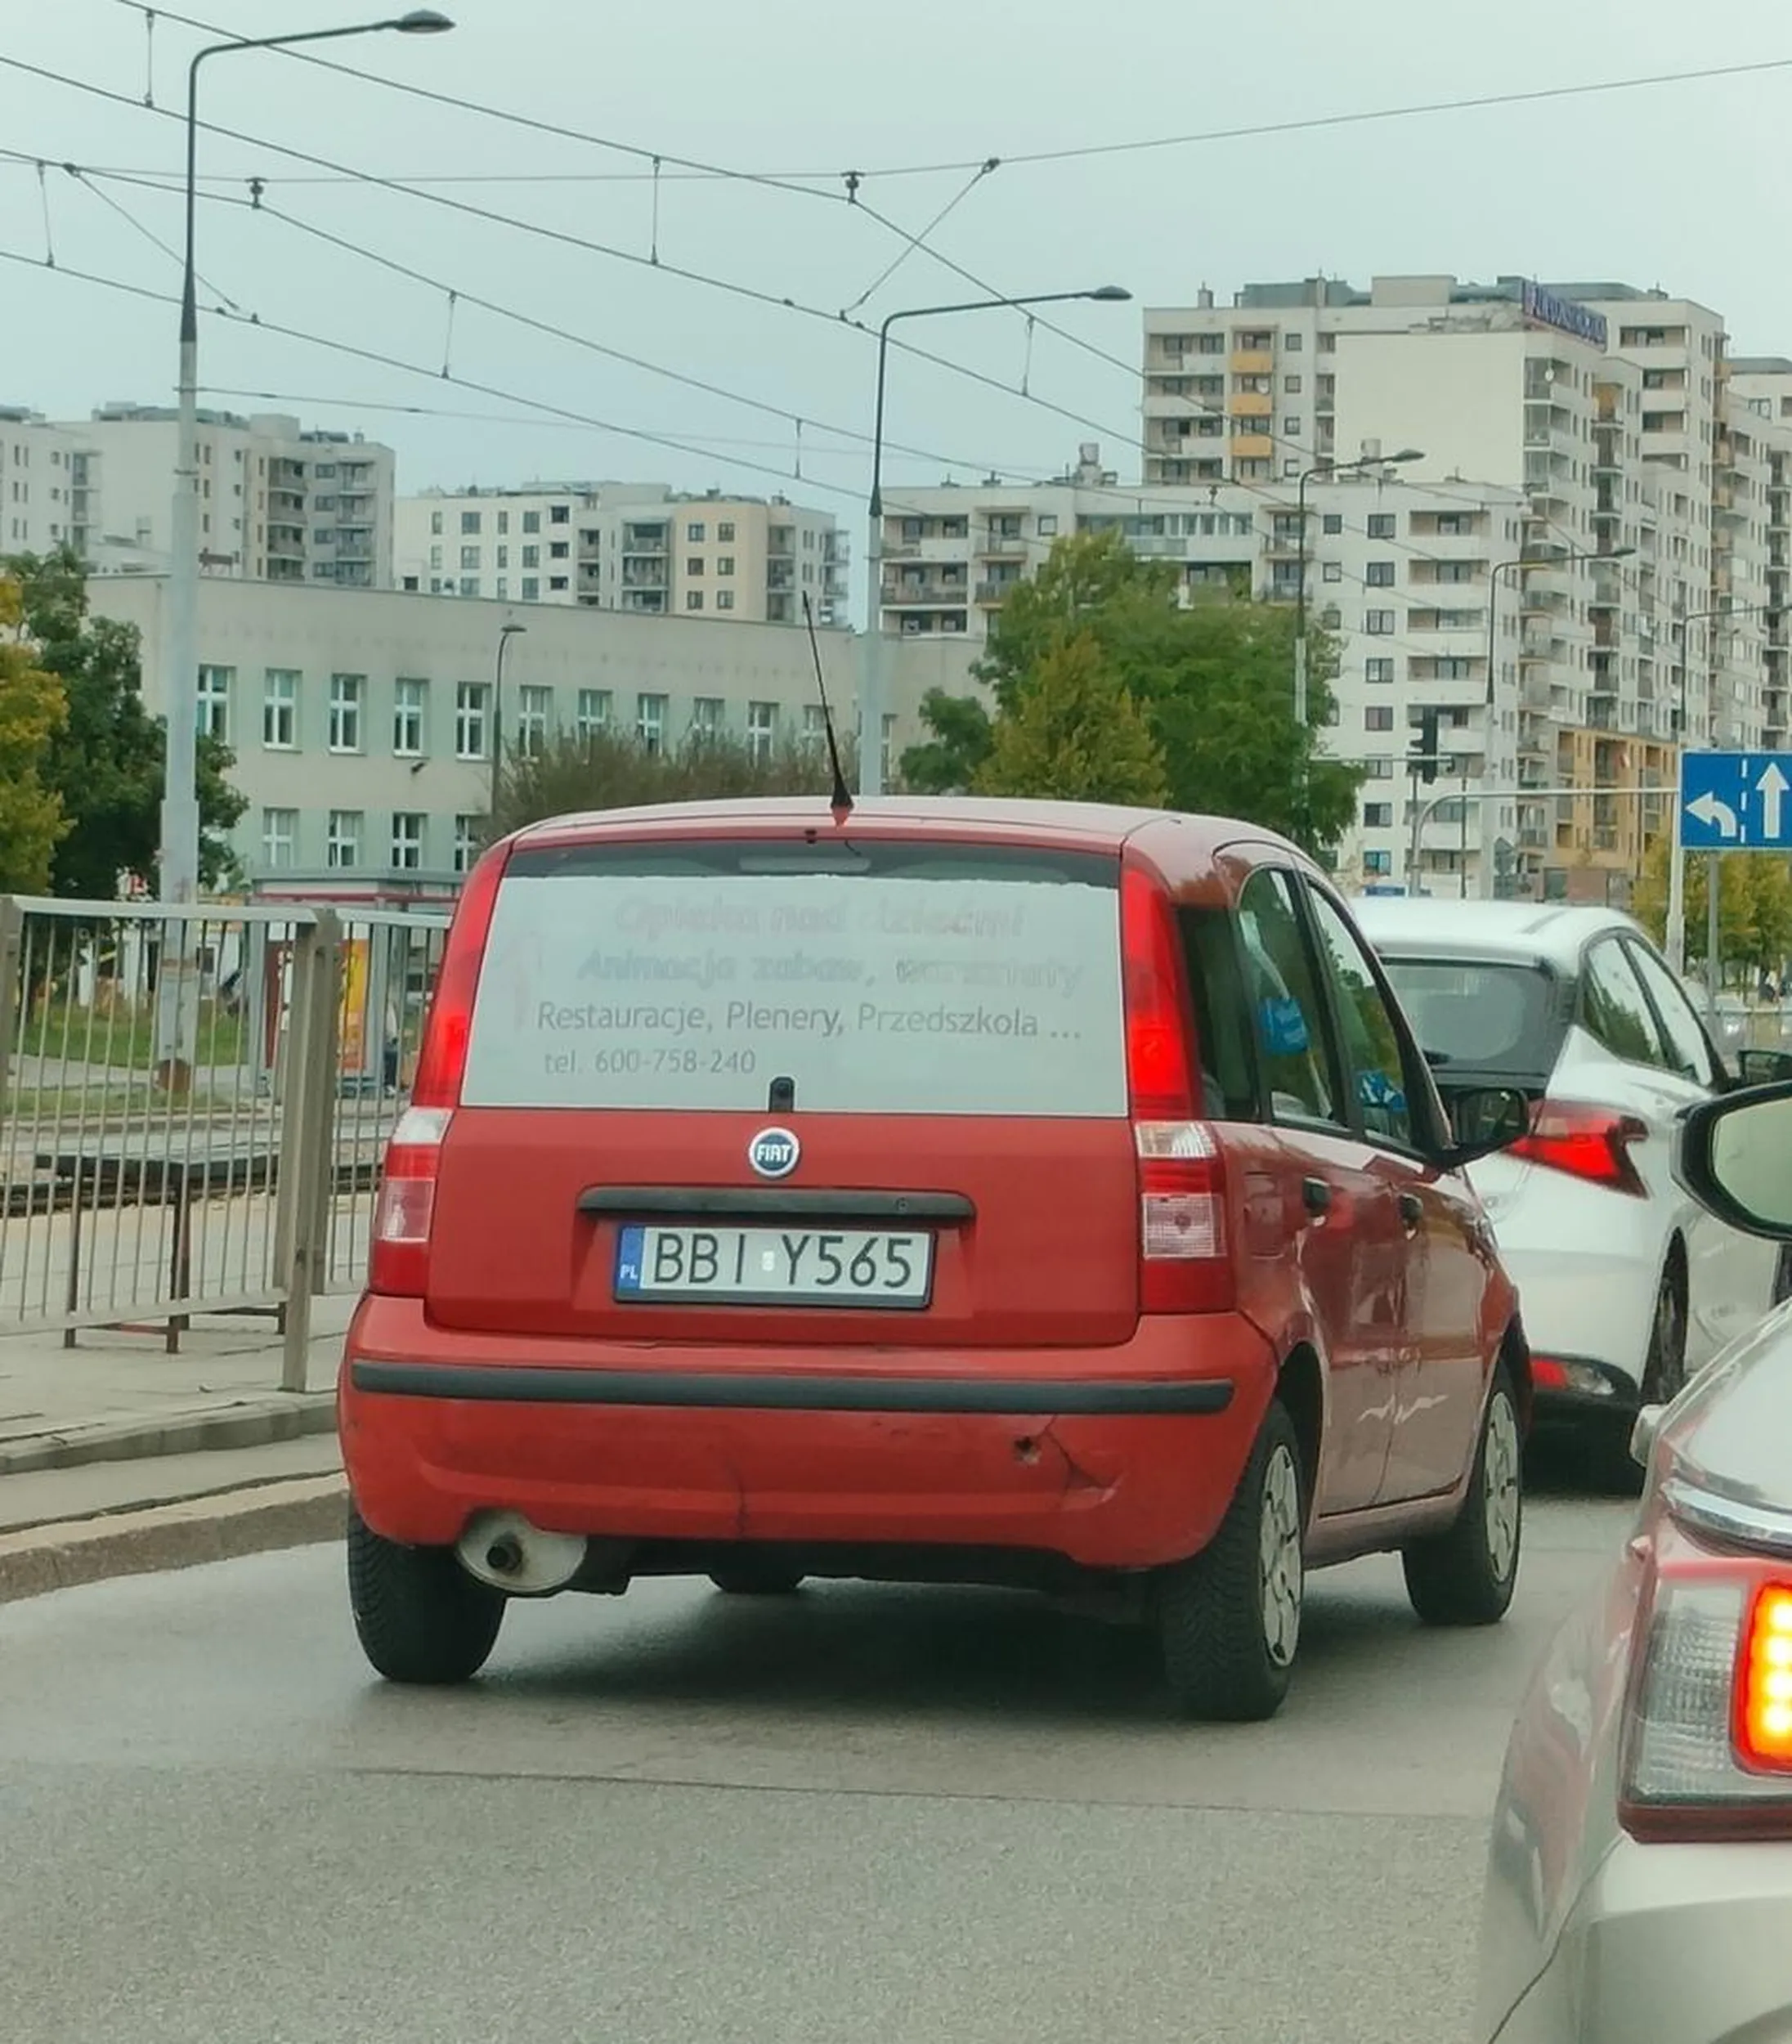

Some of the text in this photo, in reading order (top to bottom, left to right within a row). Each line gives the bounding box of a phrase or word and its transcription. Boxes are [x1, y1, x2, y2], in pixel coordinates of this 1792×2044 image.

[576, 948, 736, 990] Animacja
[537, 1001, 714, 1034] Restauracje,
[727, 1001, 844, 1037] Plenery,
[858, 1003, 1039, 1037] Przedszkola
[544, 1051, 756, 1075] tel. 600-758-240
[756, 1144, 792, 1162] FIAT
[620, 1265, 638, 1280] PL
[782, 1235, 912, 1288] Y565
